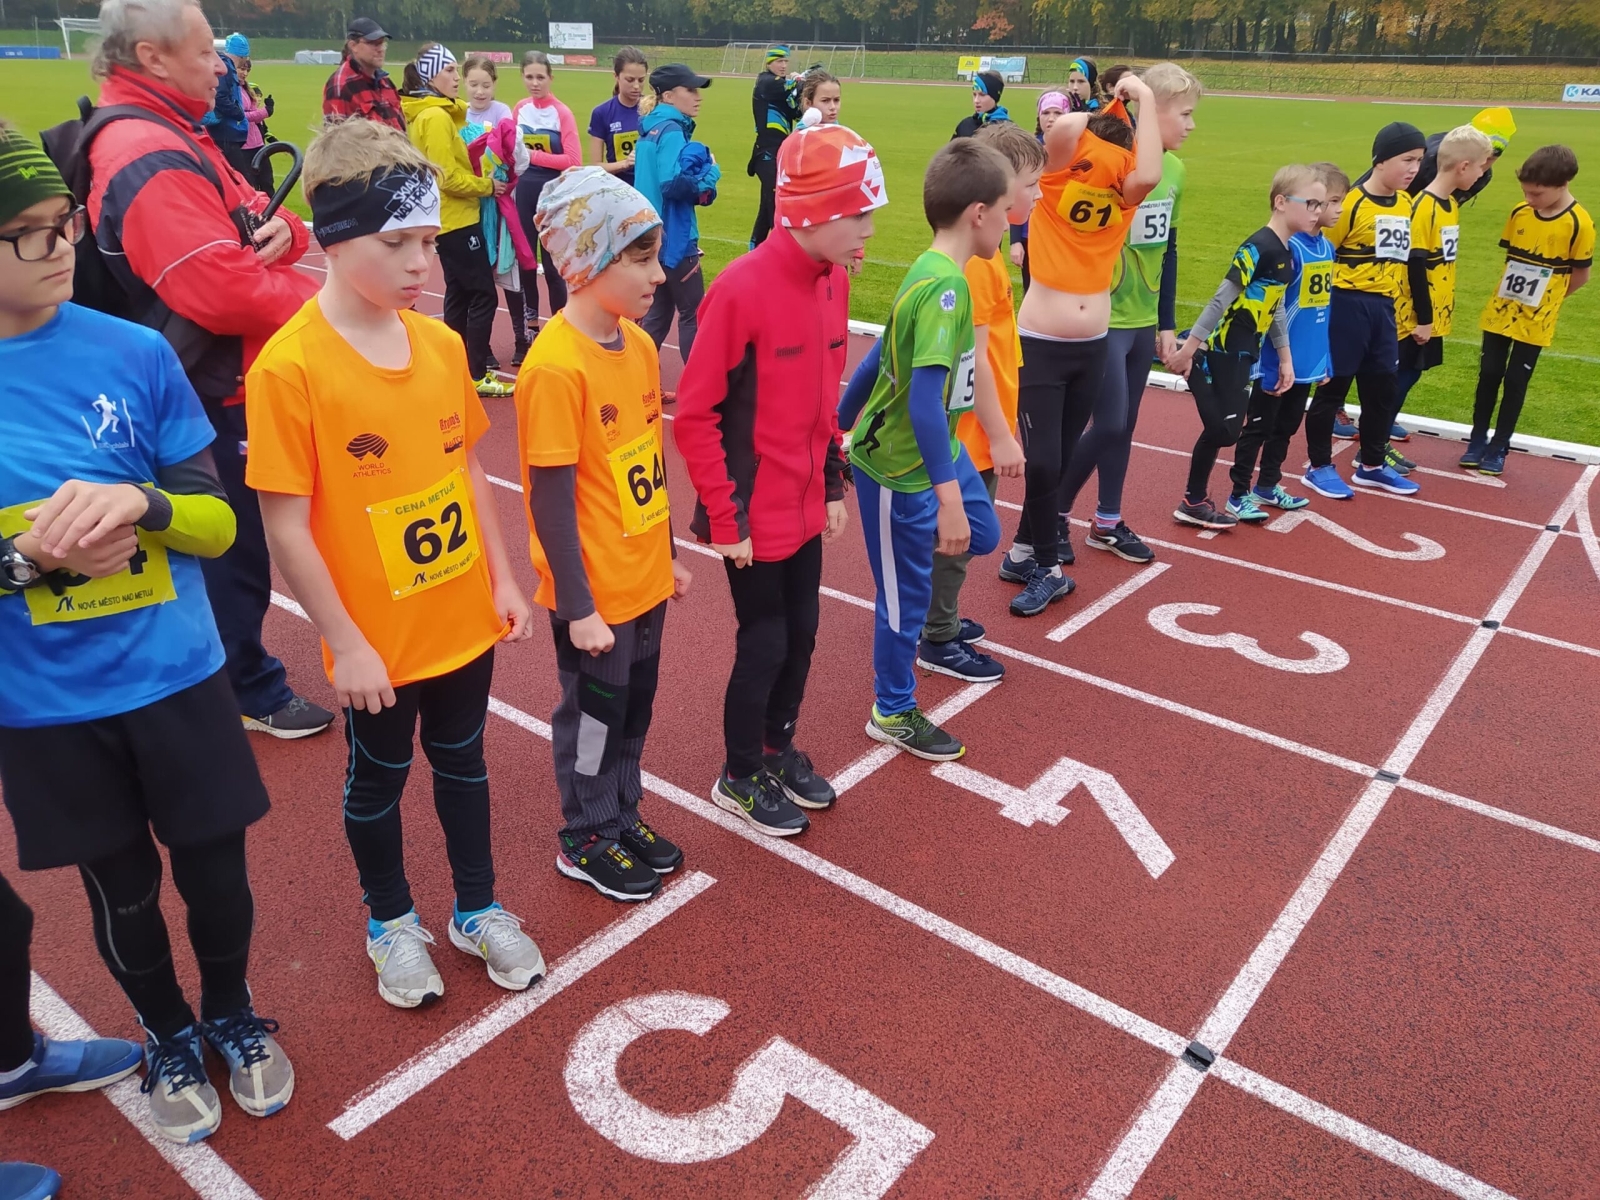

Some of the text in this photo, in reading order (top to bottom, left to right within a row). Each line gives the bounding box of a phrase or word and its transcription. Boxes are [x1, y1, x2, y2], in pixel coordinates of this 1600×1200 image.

[392, 201, 413, 222] NAD
[1069, 200, 1112, 227] 61
[1144, 213, 1167, 239] 53
[1378, 228, 1410, 251] 295
[1445, 238, 1458, 258] 2
[1309, 273, 1331, 295] 88
[1506, 273, 1540, 297] 181
[353, 467, 392, 478] ATHLETICS
[358, 462, 385, 471] WORLD
[628, 452, 666, 507] 64
[395, 481, 456, 516] CENA METUJE
[404, 501, 468, 565] 62
[1265, 509, 1446, 561] 2
[429, 570, 443, 582] NOVÉ
[78, 599, 97, 611] NOVÉ
[98, 596, 121, 607] MĚSTO
[122, 592, 134, 602] NAD
[1147, 602, 1350, 674] 3
[930, 756, 1176, 880] 4
[562, 989, 936, 1200] 5
